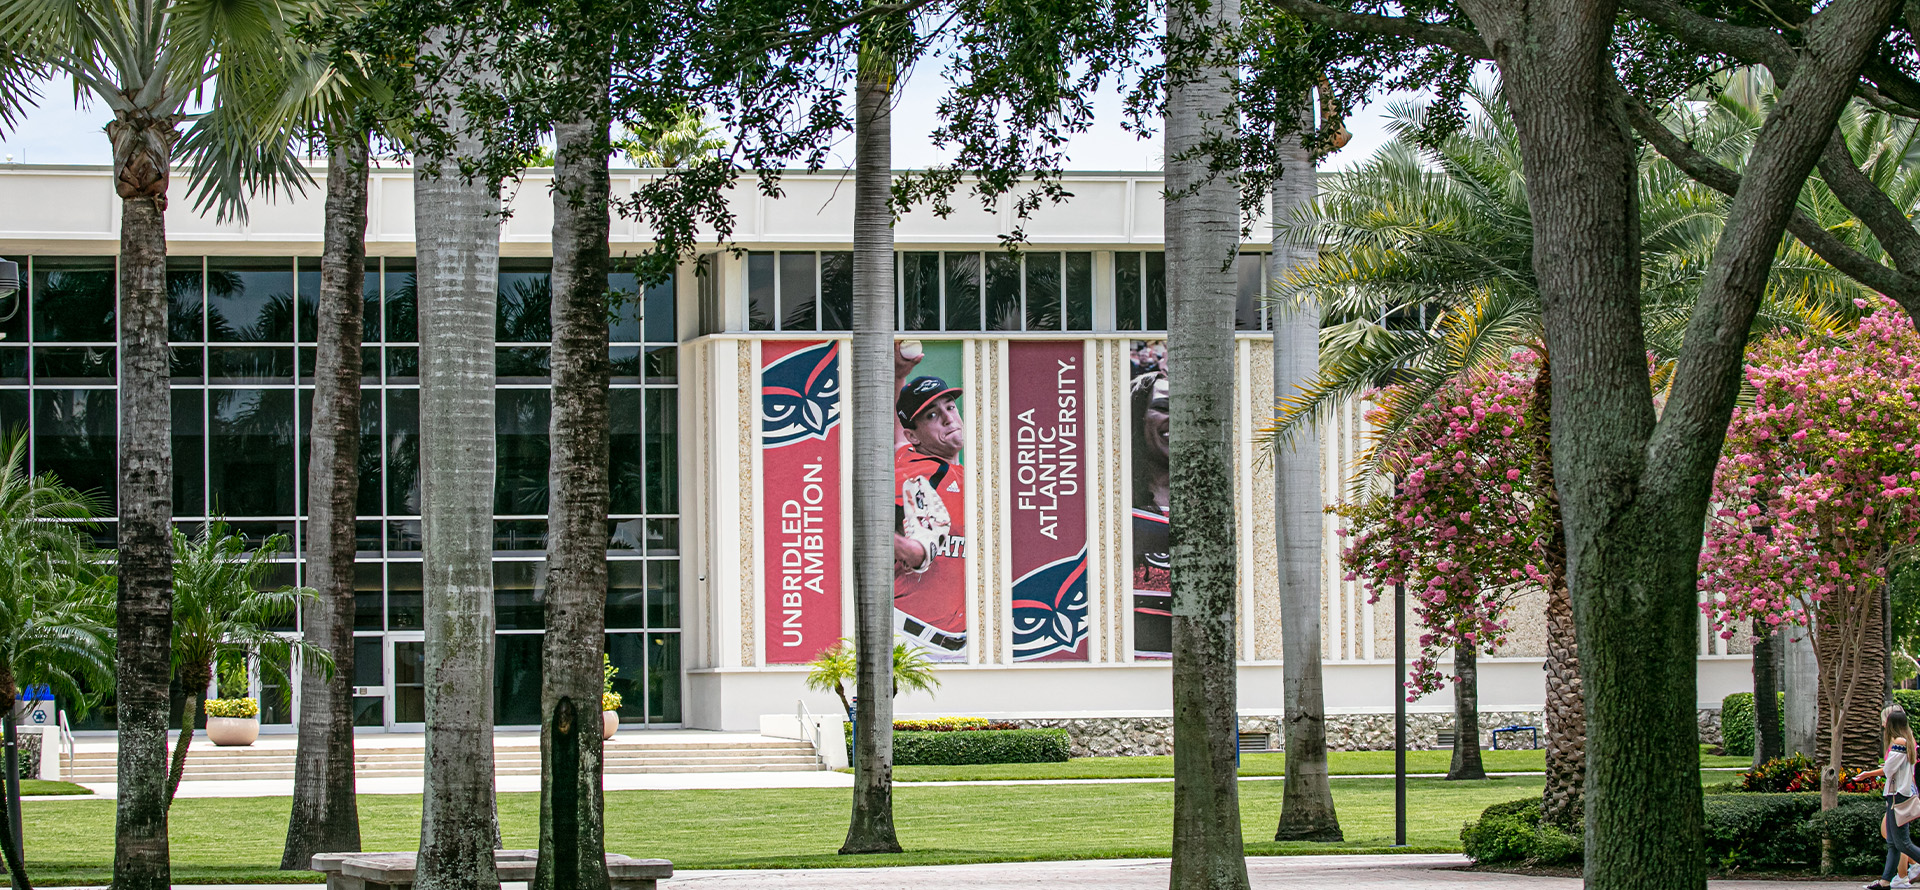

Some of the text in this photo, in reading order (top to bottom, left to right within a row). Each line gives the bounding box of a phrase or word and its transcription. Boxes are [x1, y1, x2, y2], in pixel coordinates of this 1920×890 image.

[1018, 408, 1036, 510] FLORIDA
[1039, 427, 1058, 540] ATLANTIC
[782, 500, 802, 647] UNBRIDLED
